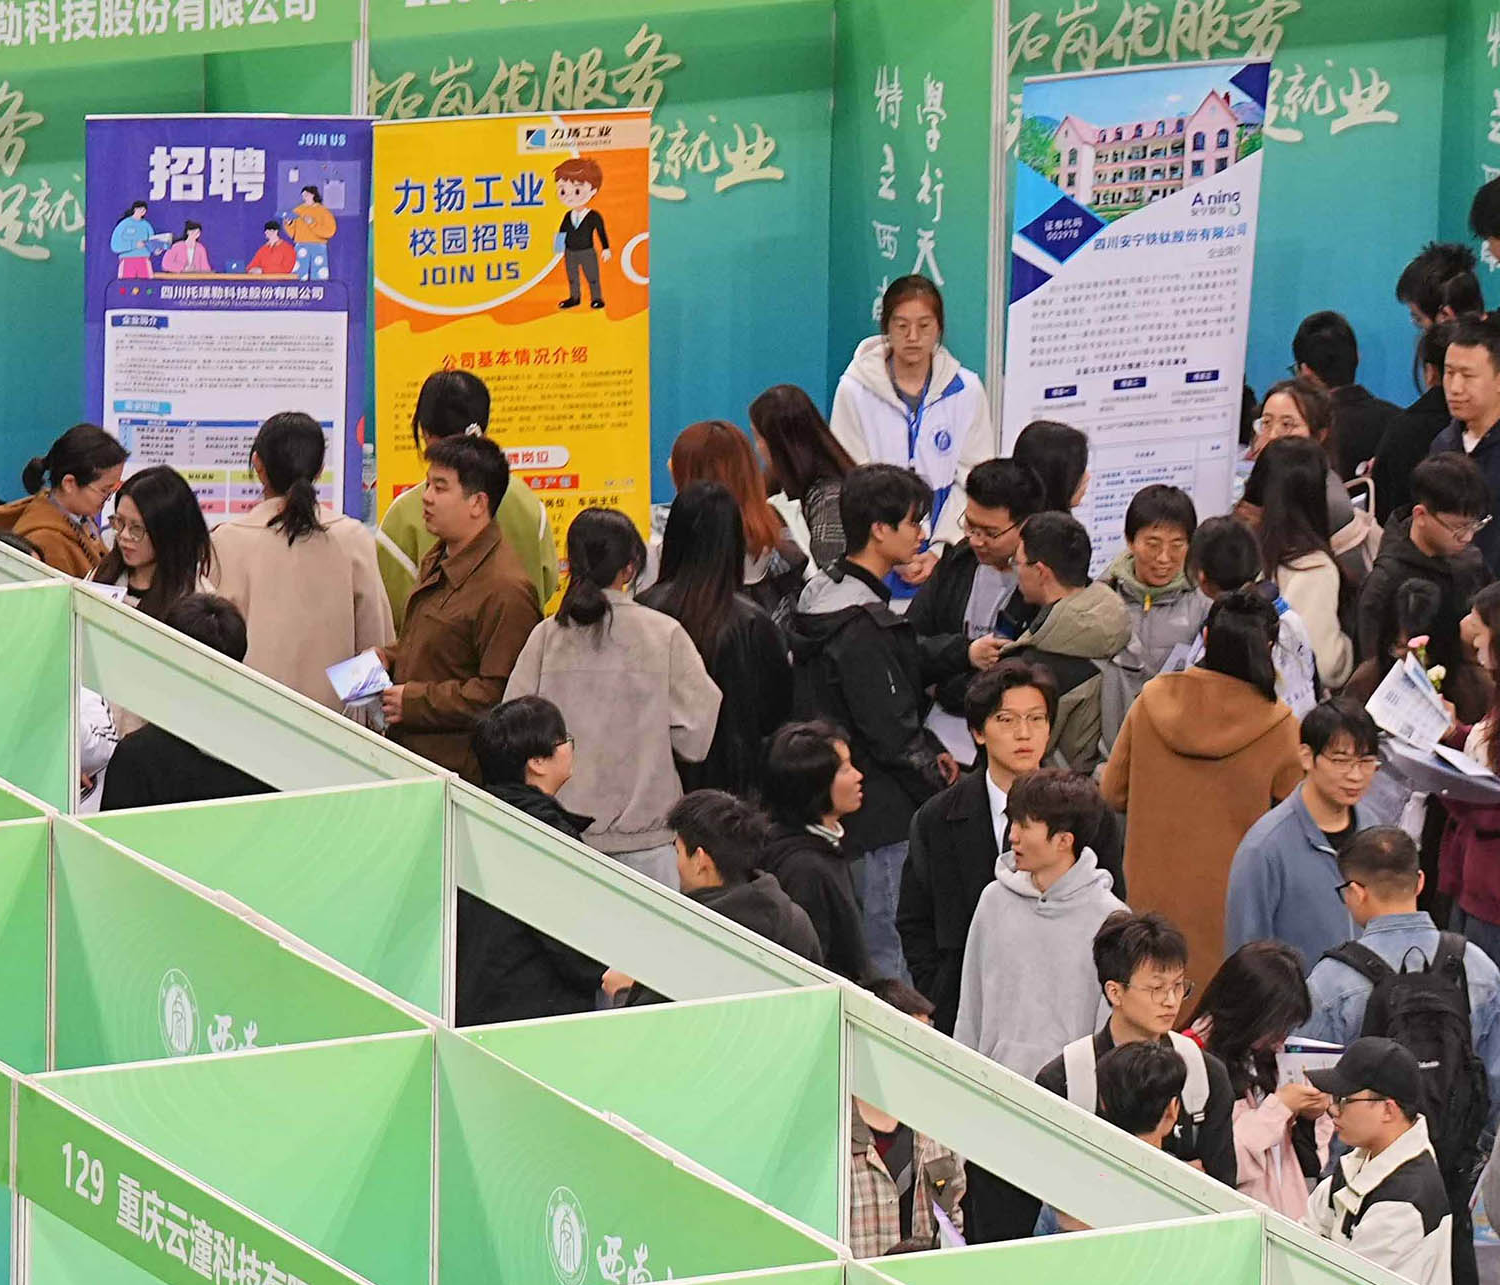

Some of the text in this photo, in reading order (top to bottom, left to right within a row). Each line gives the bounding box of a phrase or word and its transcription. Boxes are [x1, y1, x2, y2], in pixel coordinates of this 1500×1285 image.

[299, 133, 346, 146] JOIN US
[551, 126, 612, 139] 力扬工业
[149, 146, 265, 202] 招聘
[393, 172, 545, 216] 力扬工业
[409, 222, 530, 257] 校园招聘
[1093, 223, 1247, 251] 四川安宁铁钛股份有限公司
[420, 262, 520, 286] JOIN US
[442, 346, 587, 369] 公司基本情况介绍
[61, 1142, 104, 1205] 129
